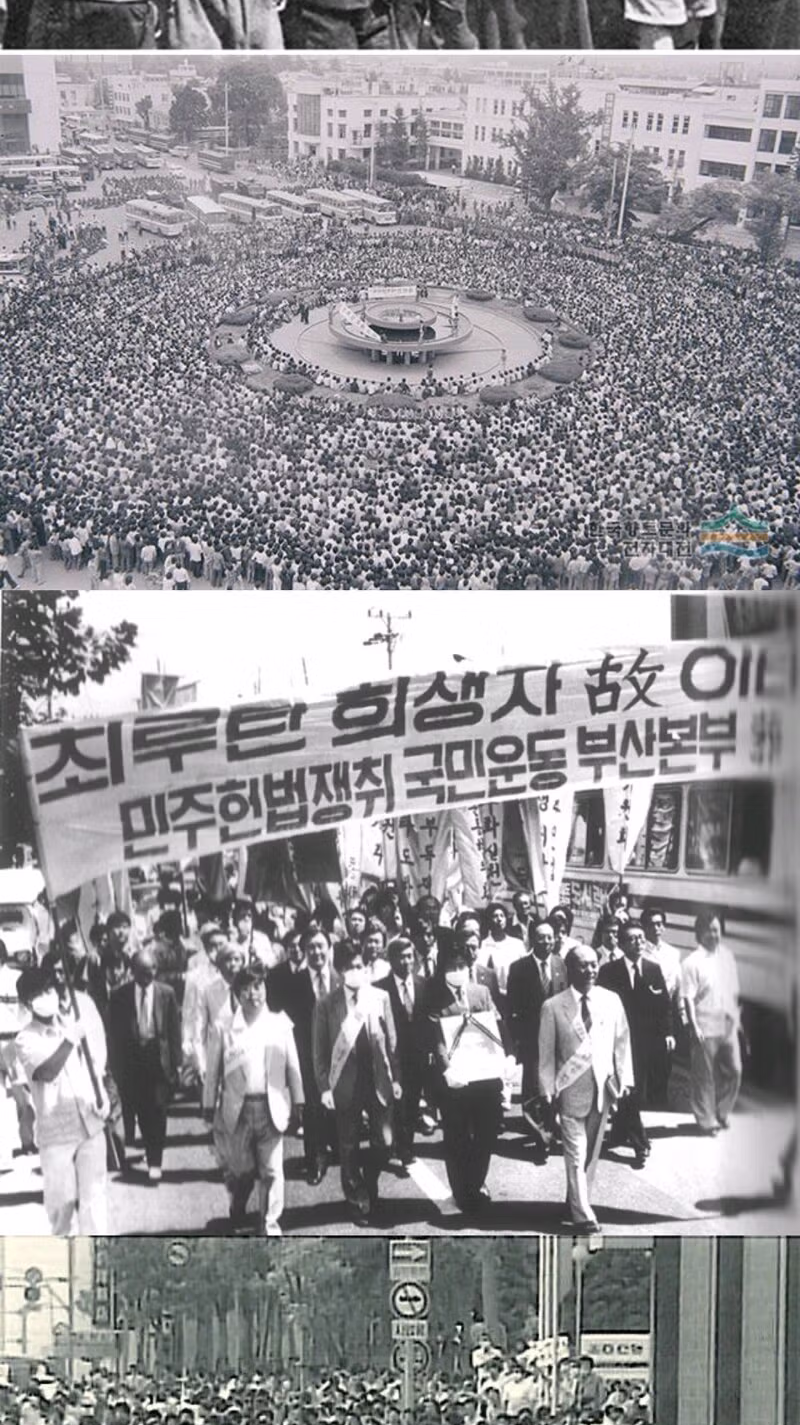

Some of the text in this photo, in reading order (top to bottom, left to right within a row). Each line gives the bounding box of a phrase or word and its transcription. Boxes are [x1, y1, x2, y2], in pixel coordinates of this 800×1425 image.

[30, 702, 308, 805] 최루탄
[332, 661, 563, 747] 희생자
[584, 647, 665, 716] 故
[120, 754, 394, 860] 민주헌법쟁취
[404, 728, 567, 804] 국민운동
[577, 712, 736, 782] 부산본부
